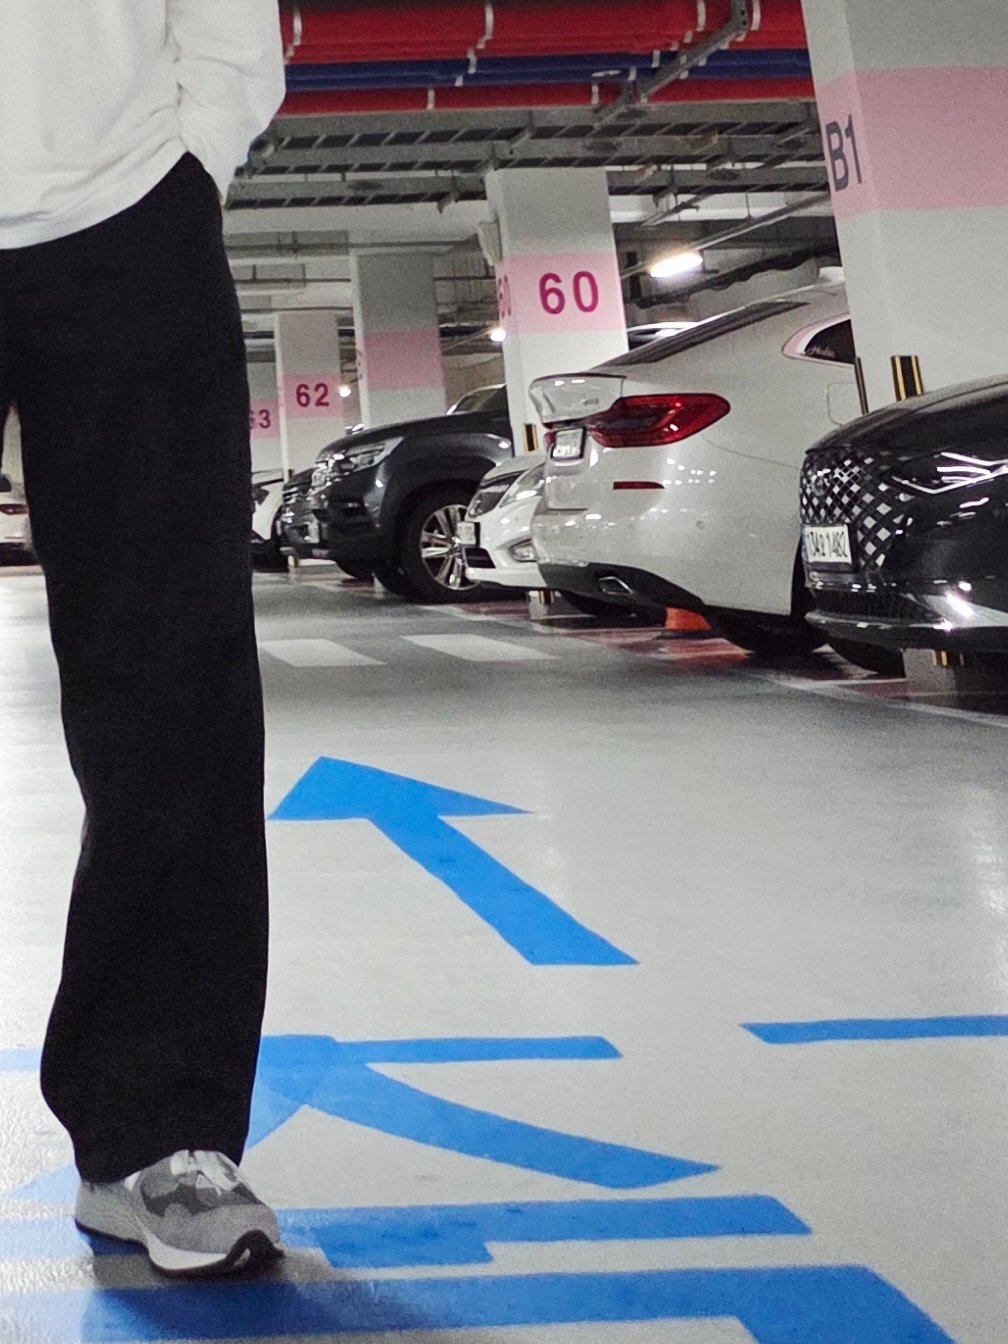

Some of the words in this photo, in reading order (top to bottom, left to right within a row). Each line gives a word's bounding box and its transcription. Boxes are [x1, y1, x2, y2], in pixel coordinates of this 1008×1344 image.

[825, 113, 862, 192] B1
[538, 270, 599, 315] 60
[296, 382, 330, 408] 62
